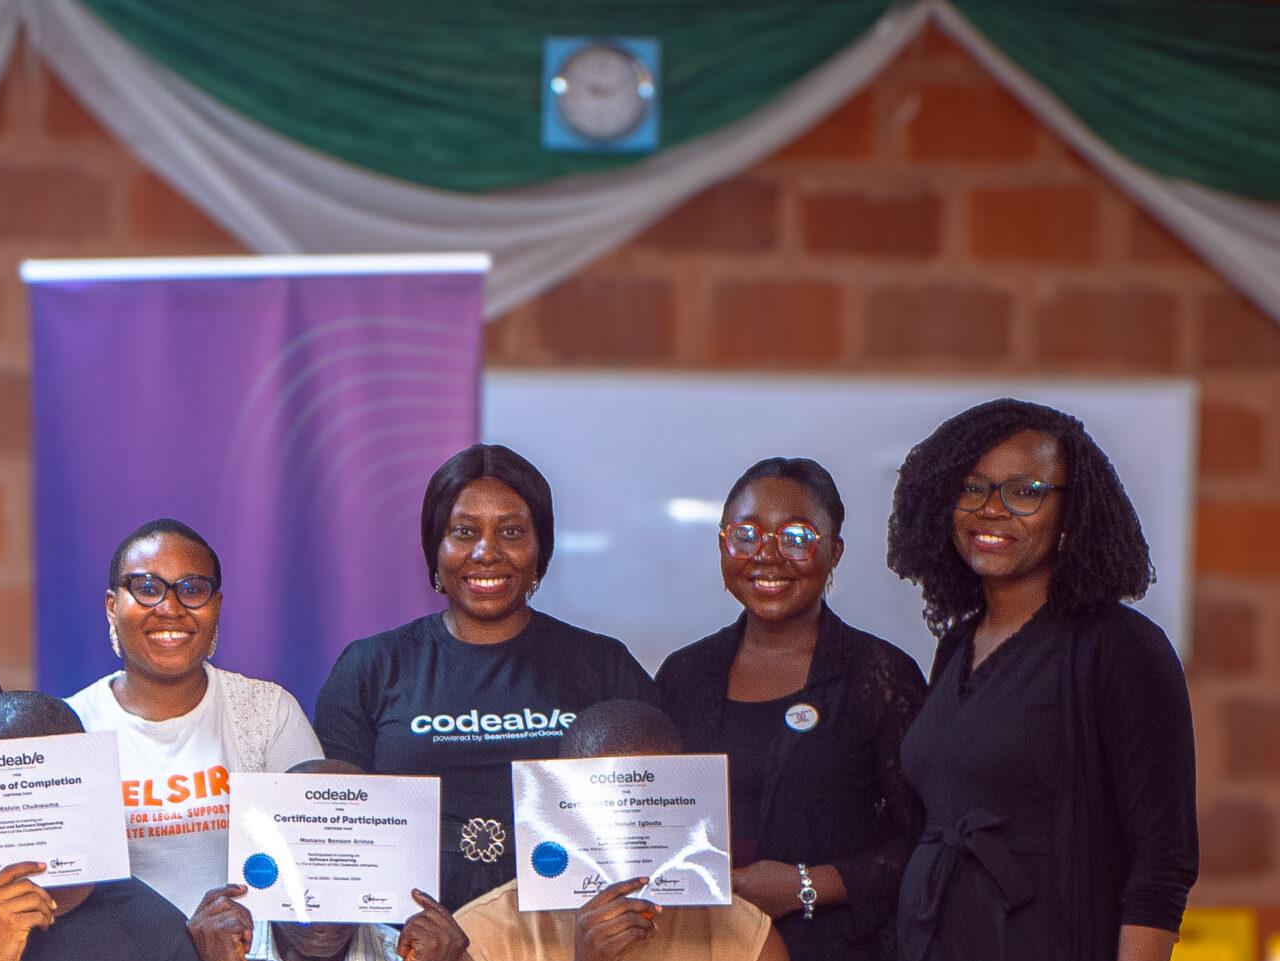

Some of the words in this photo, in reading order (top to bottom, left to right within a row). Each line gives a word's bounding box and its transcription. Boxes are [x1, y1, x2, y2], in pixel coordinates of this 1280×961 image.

[432, 734, 471, 743] powered
[471, 734, 483, 743] by
[483, 730, 564, 741] SeamlessForGood
[7, 781, 19, 790] of
[20, 776, 82, 789] Completion
[121, 765, 231, 807] ELSIR
[617, 797, 628, 806] of
[629, 796, 697, 808] Participation
[130, 813, 149, 824] FOR
[152, 811, 183, 822] LEGAL
[187, 804, 230, 818] SUPPORT
[273, 813, 328, 823] Certificate
[329, 815, 341, 824] of
[342, 815, 408, 826] Participation
[147, 818, 230, 838] REHABILITATIO
